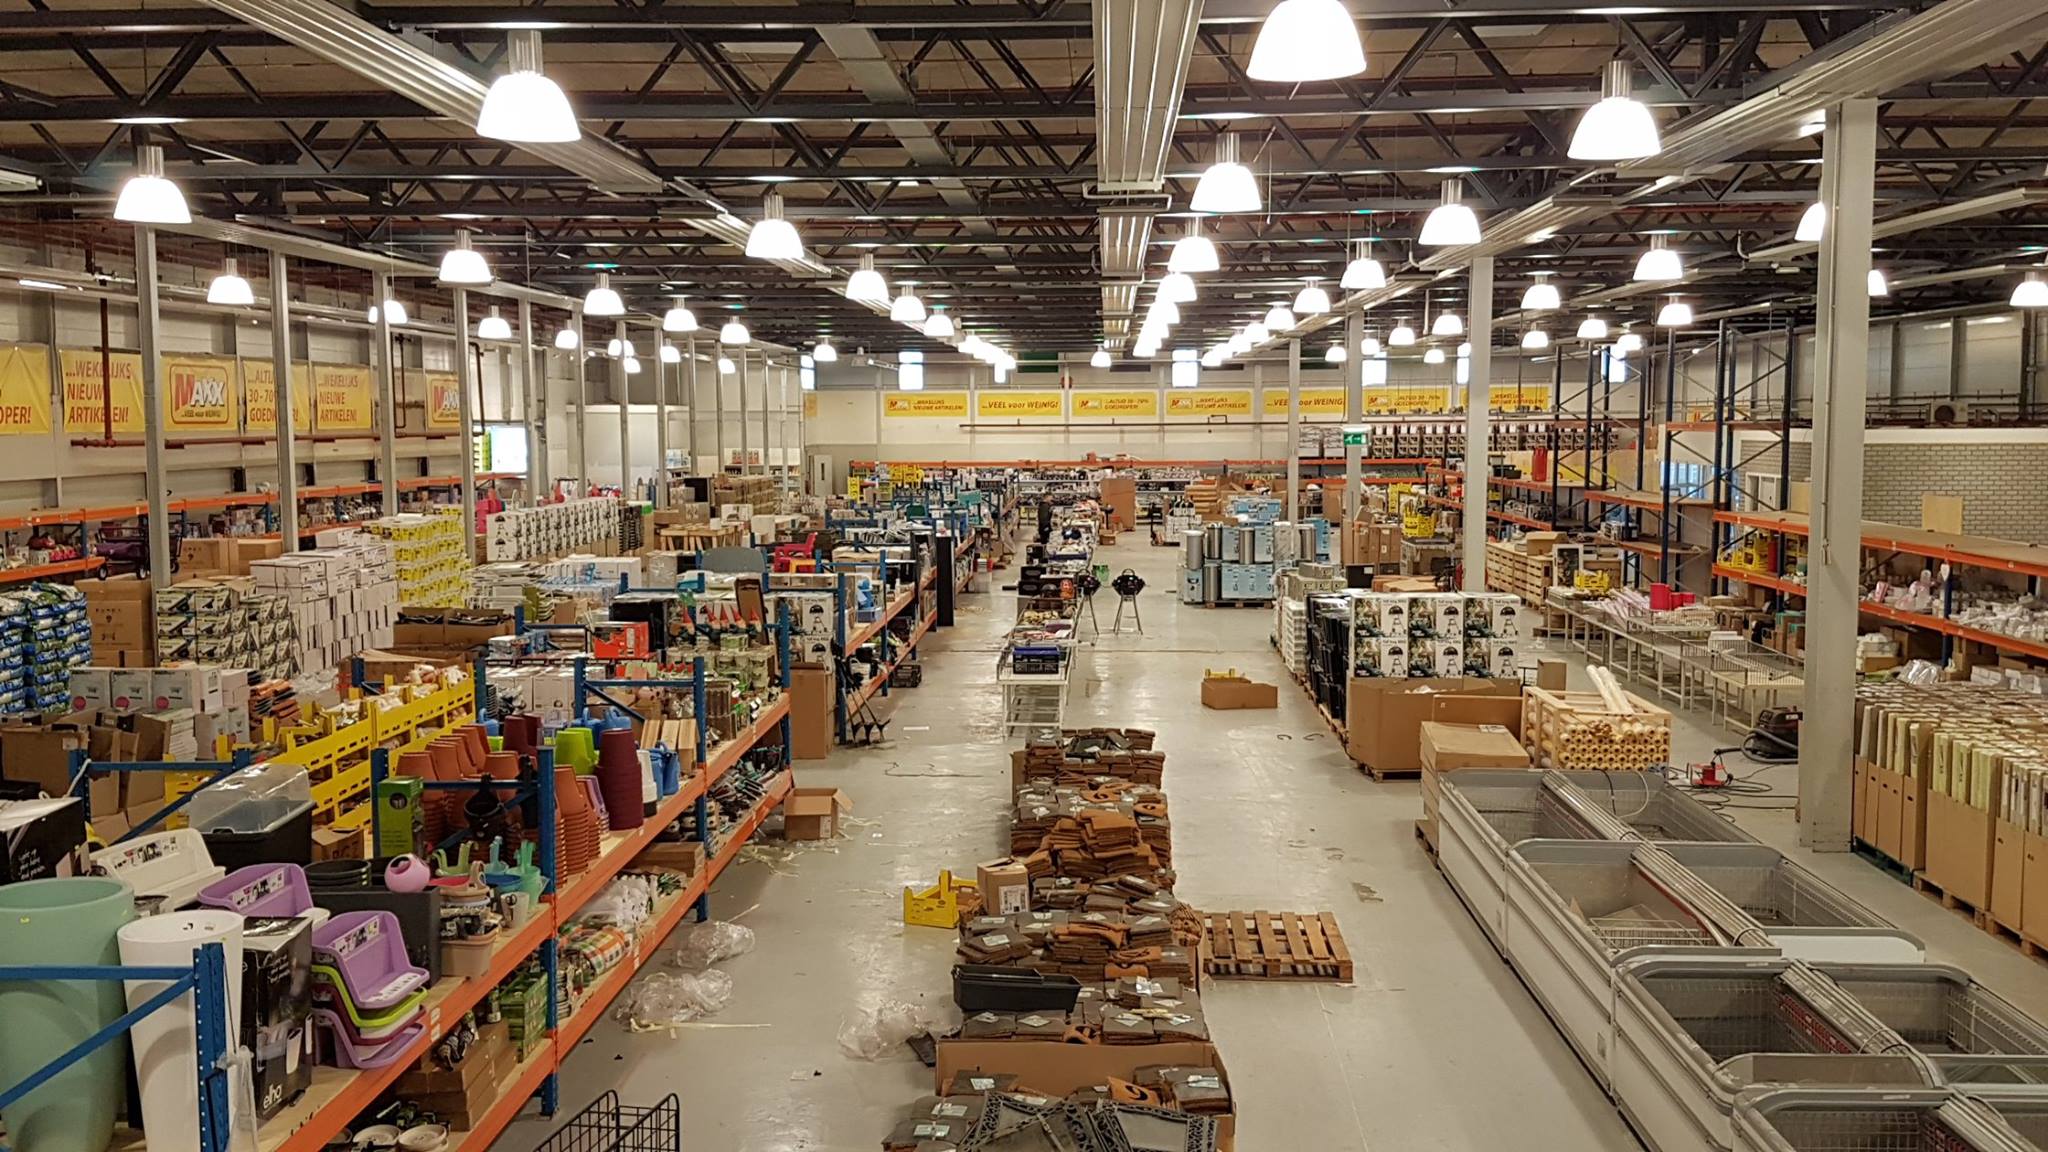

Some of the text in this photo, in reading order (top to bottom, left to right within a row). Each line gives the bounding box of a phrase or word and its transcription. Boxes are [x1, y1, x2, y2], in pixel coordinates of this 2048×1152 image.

[68, 383, 103, 400] NIEUW
[1027, 400, 1059, 409] WEINIG!
[68, 406, 129, 423] ARTIKEEN!
[263, 1083, 282, 1109] elho
